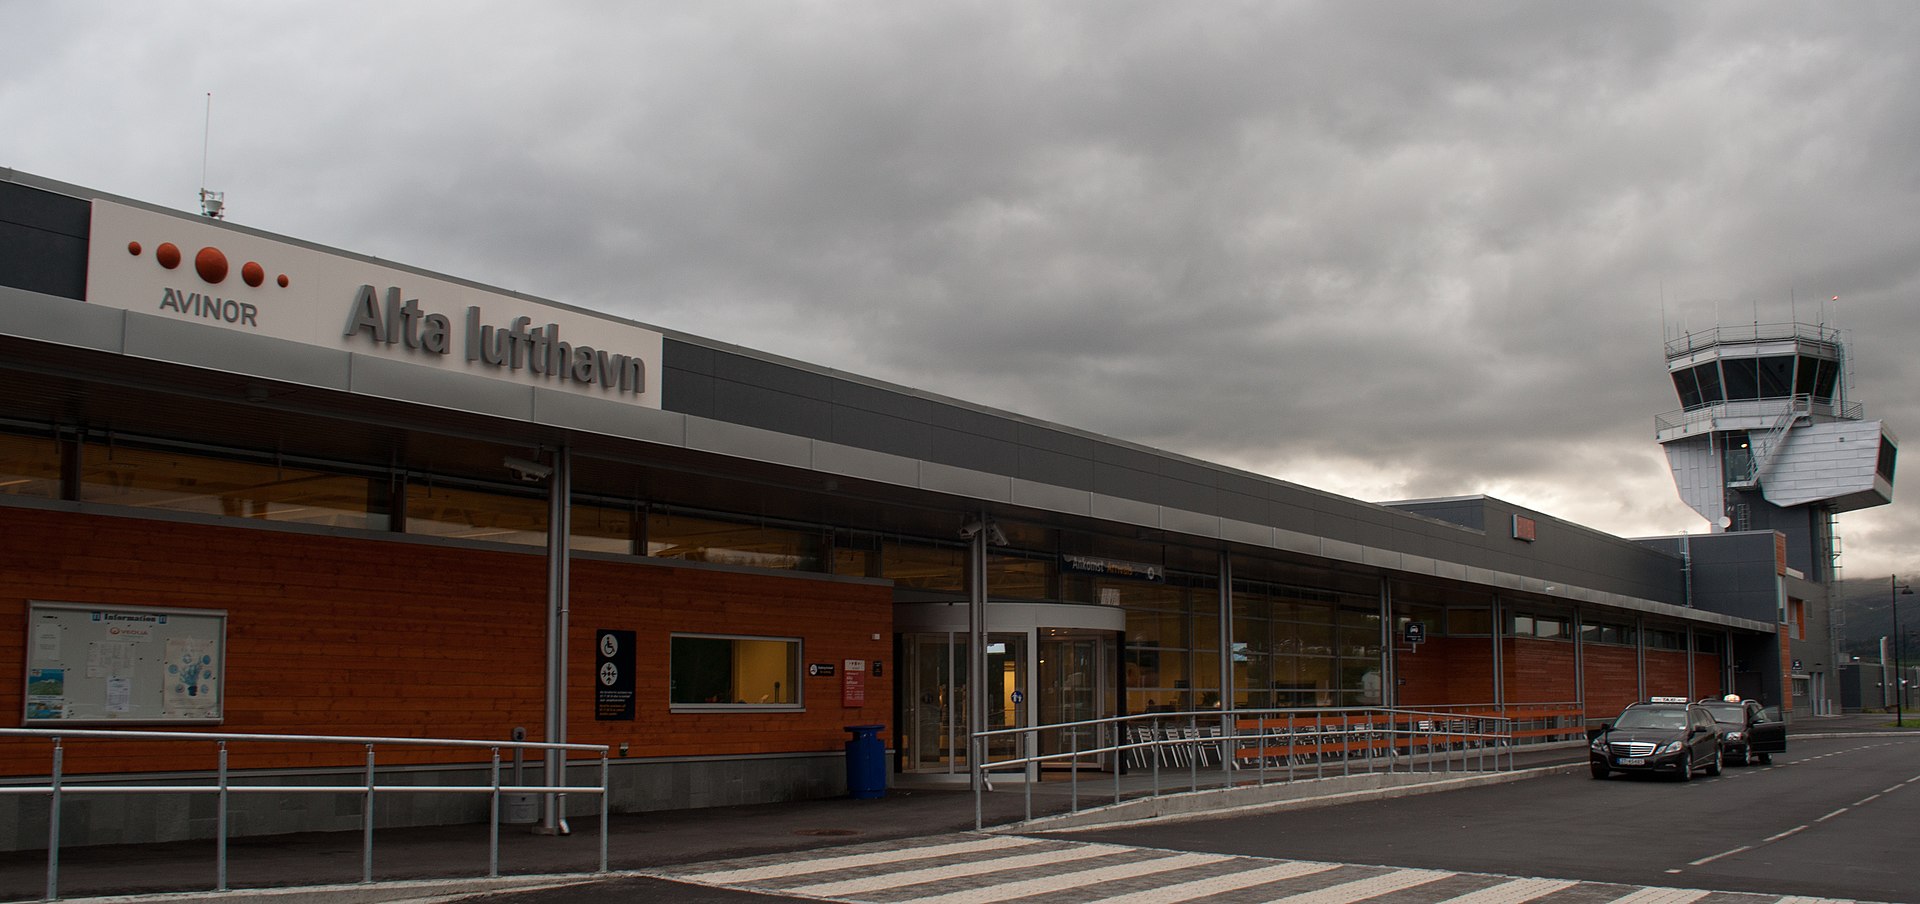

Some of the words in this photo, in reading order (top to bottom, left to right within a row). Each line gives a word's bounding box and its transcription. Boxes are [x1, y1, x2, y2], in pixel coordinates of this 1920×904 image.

[160, 287, 257, 327] AVINOR
[344, 284, 451, 355] Alta
[464, 306, 646, 394] lufthavn
[1072, 556, 1105, 573] Ankomst
[104, 612, 157, 623] Information
